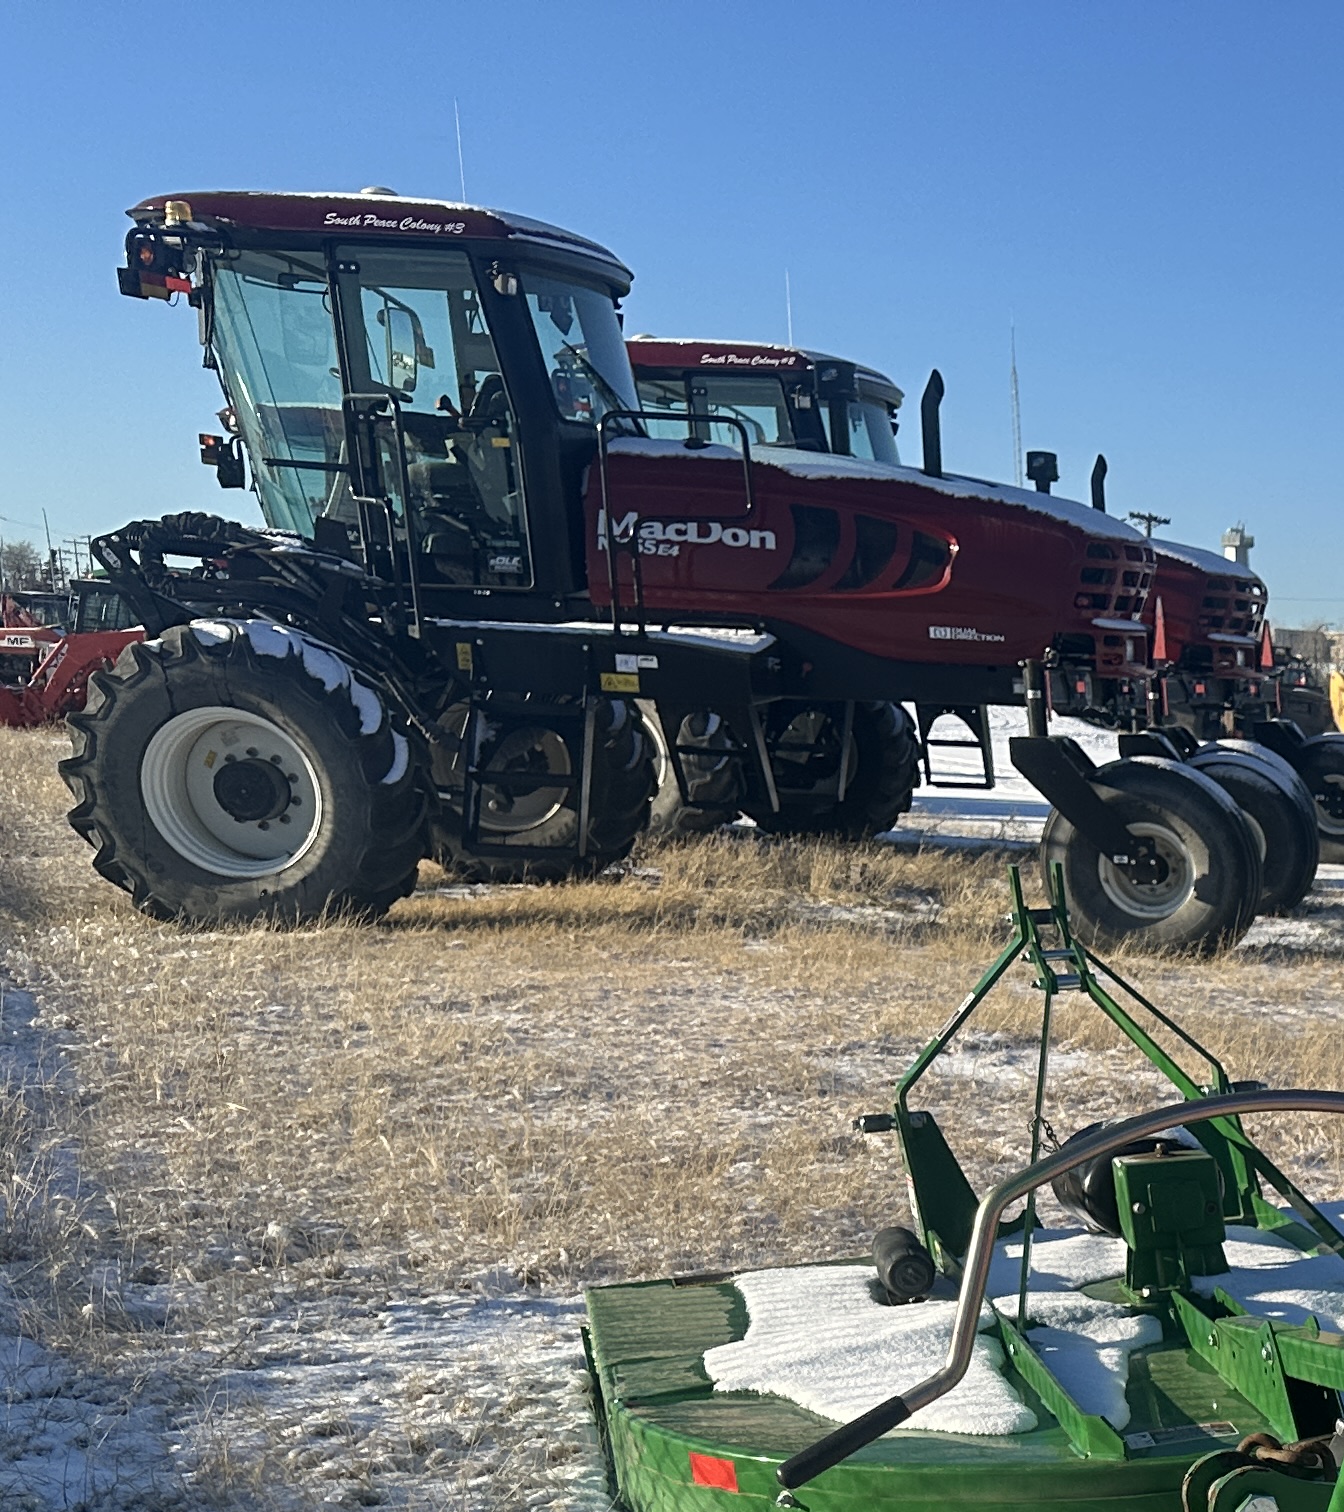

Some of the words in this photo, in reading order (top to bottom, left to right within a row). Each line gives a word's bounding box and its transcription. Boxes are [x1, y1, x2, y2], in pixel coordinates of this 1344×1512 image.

[323, 213, 361, 226] South
[363, 214, 398, 228] Peace
[399, 216, 442, 234] Colony
[444, 222, 466, 234] #3
[751, 355, 780, 367] Colony
[597, 508, 777, 551] MacDon
[7, 637, 30, 646] MF
